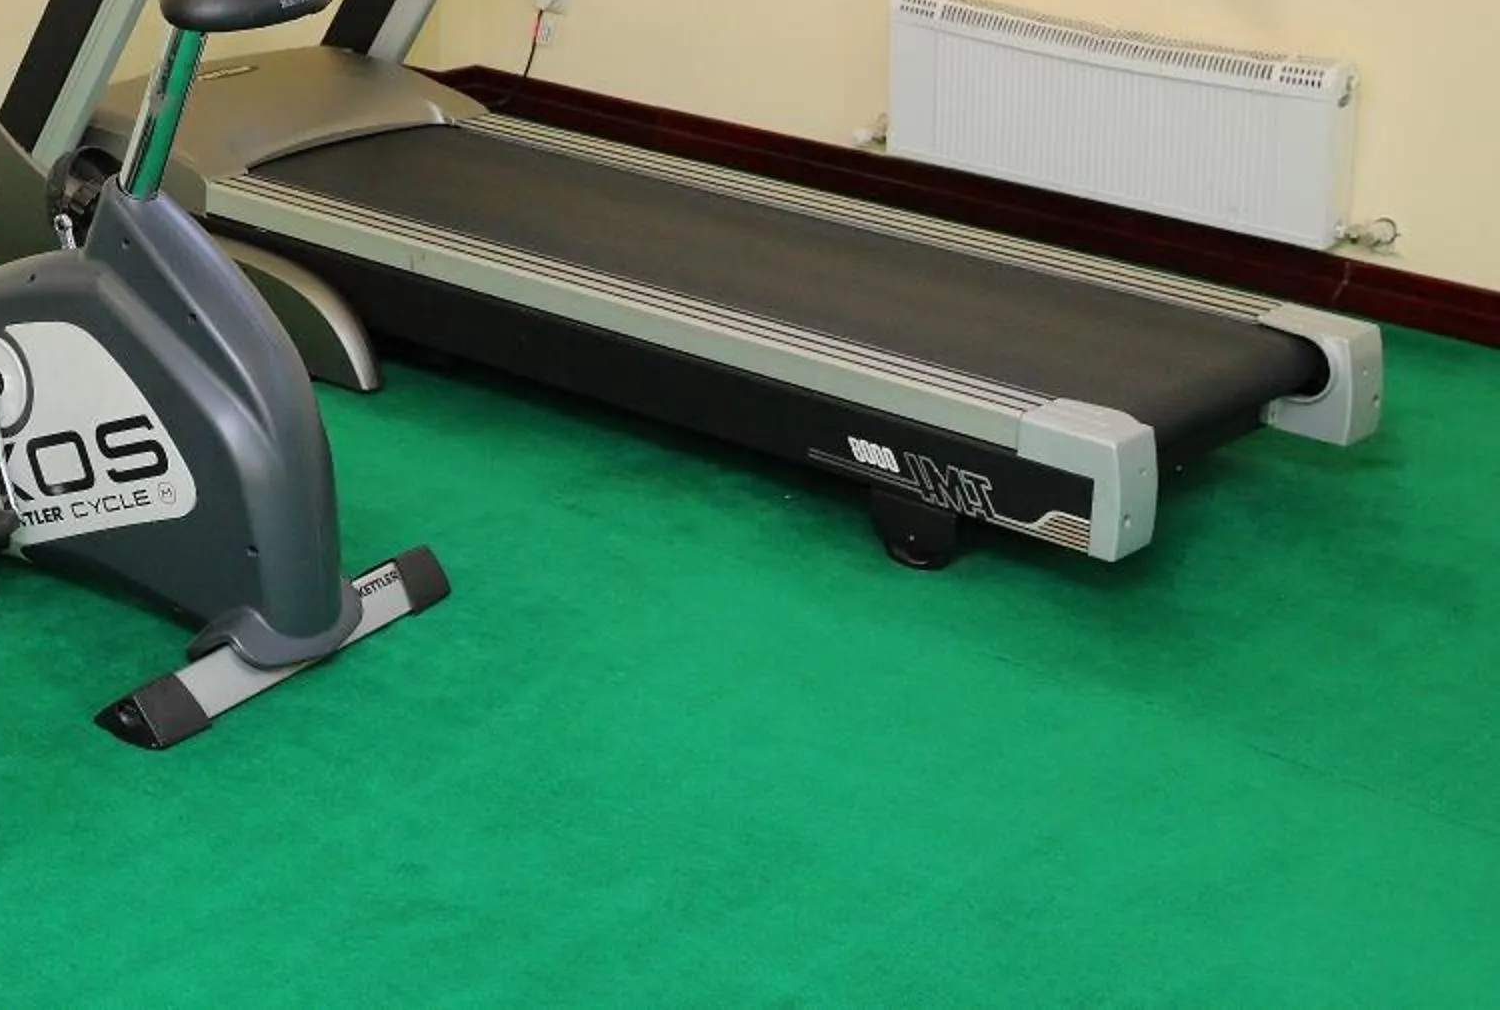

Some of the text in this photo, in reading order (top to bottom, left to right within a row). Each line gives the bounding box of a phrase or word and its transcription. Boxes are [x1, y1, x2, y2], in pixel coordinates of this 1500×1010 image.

[20, 506, 64, 527] TLER
[70, 489, 152, 519] CYCLE
[359, 571, 399, 597] KETTLER
